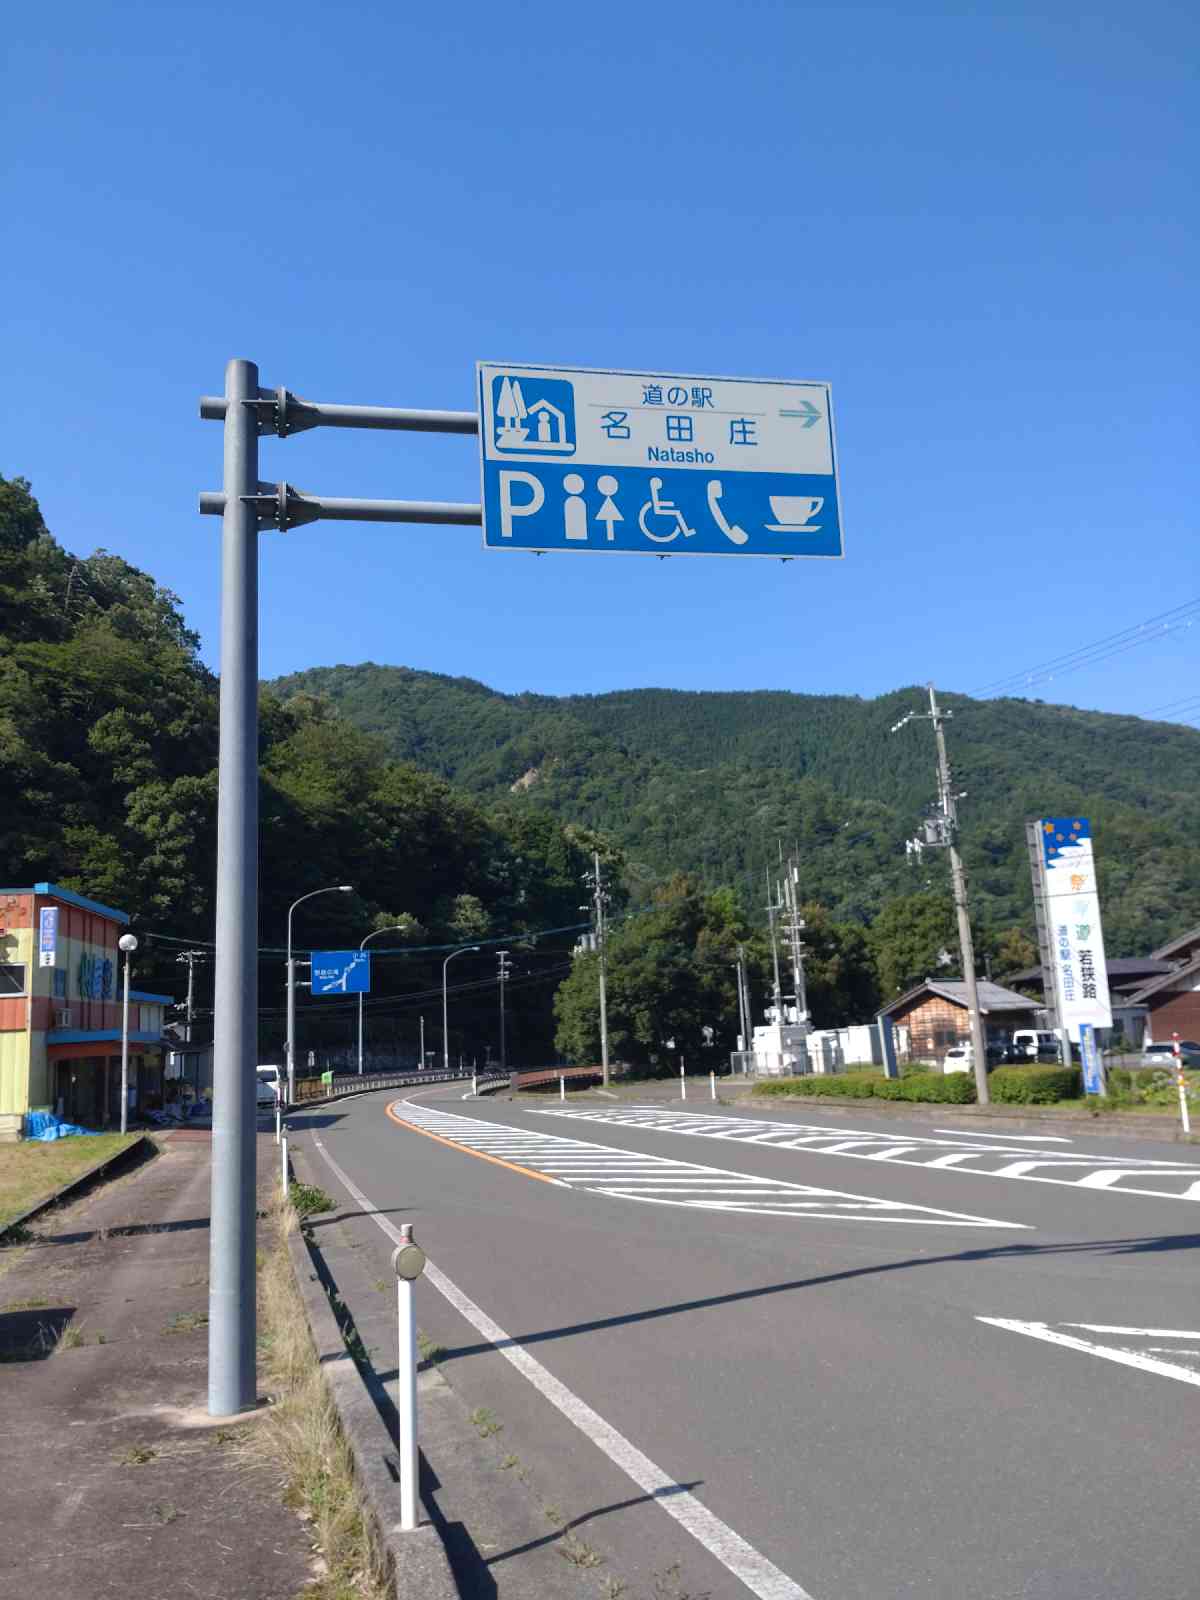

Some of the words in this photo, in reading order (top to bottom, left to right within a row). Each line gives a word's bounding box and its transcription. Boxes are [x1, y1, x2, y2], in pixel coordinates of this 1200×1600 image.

[642, 384, 715, 408] 道の駅
[600, 411, 758, 446] 名田庄
[647, 446, 715, 464] Natasho
[499, 469, 545, 538] P
